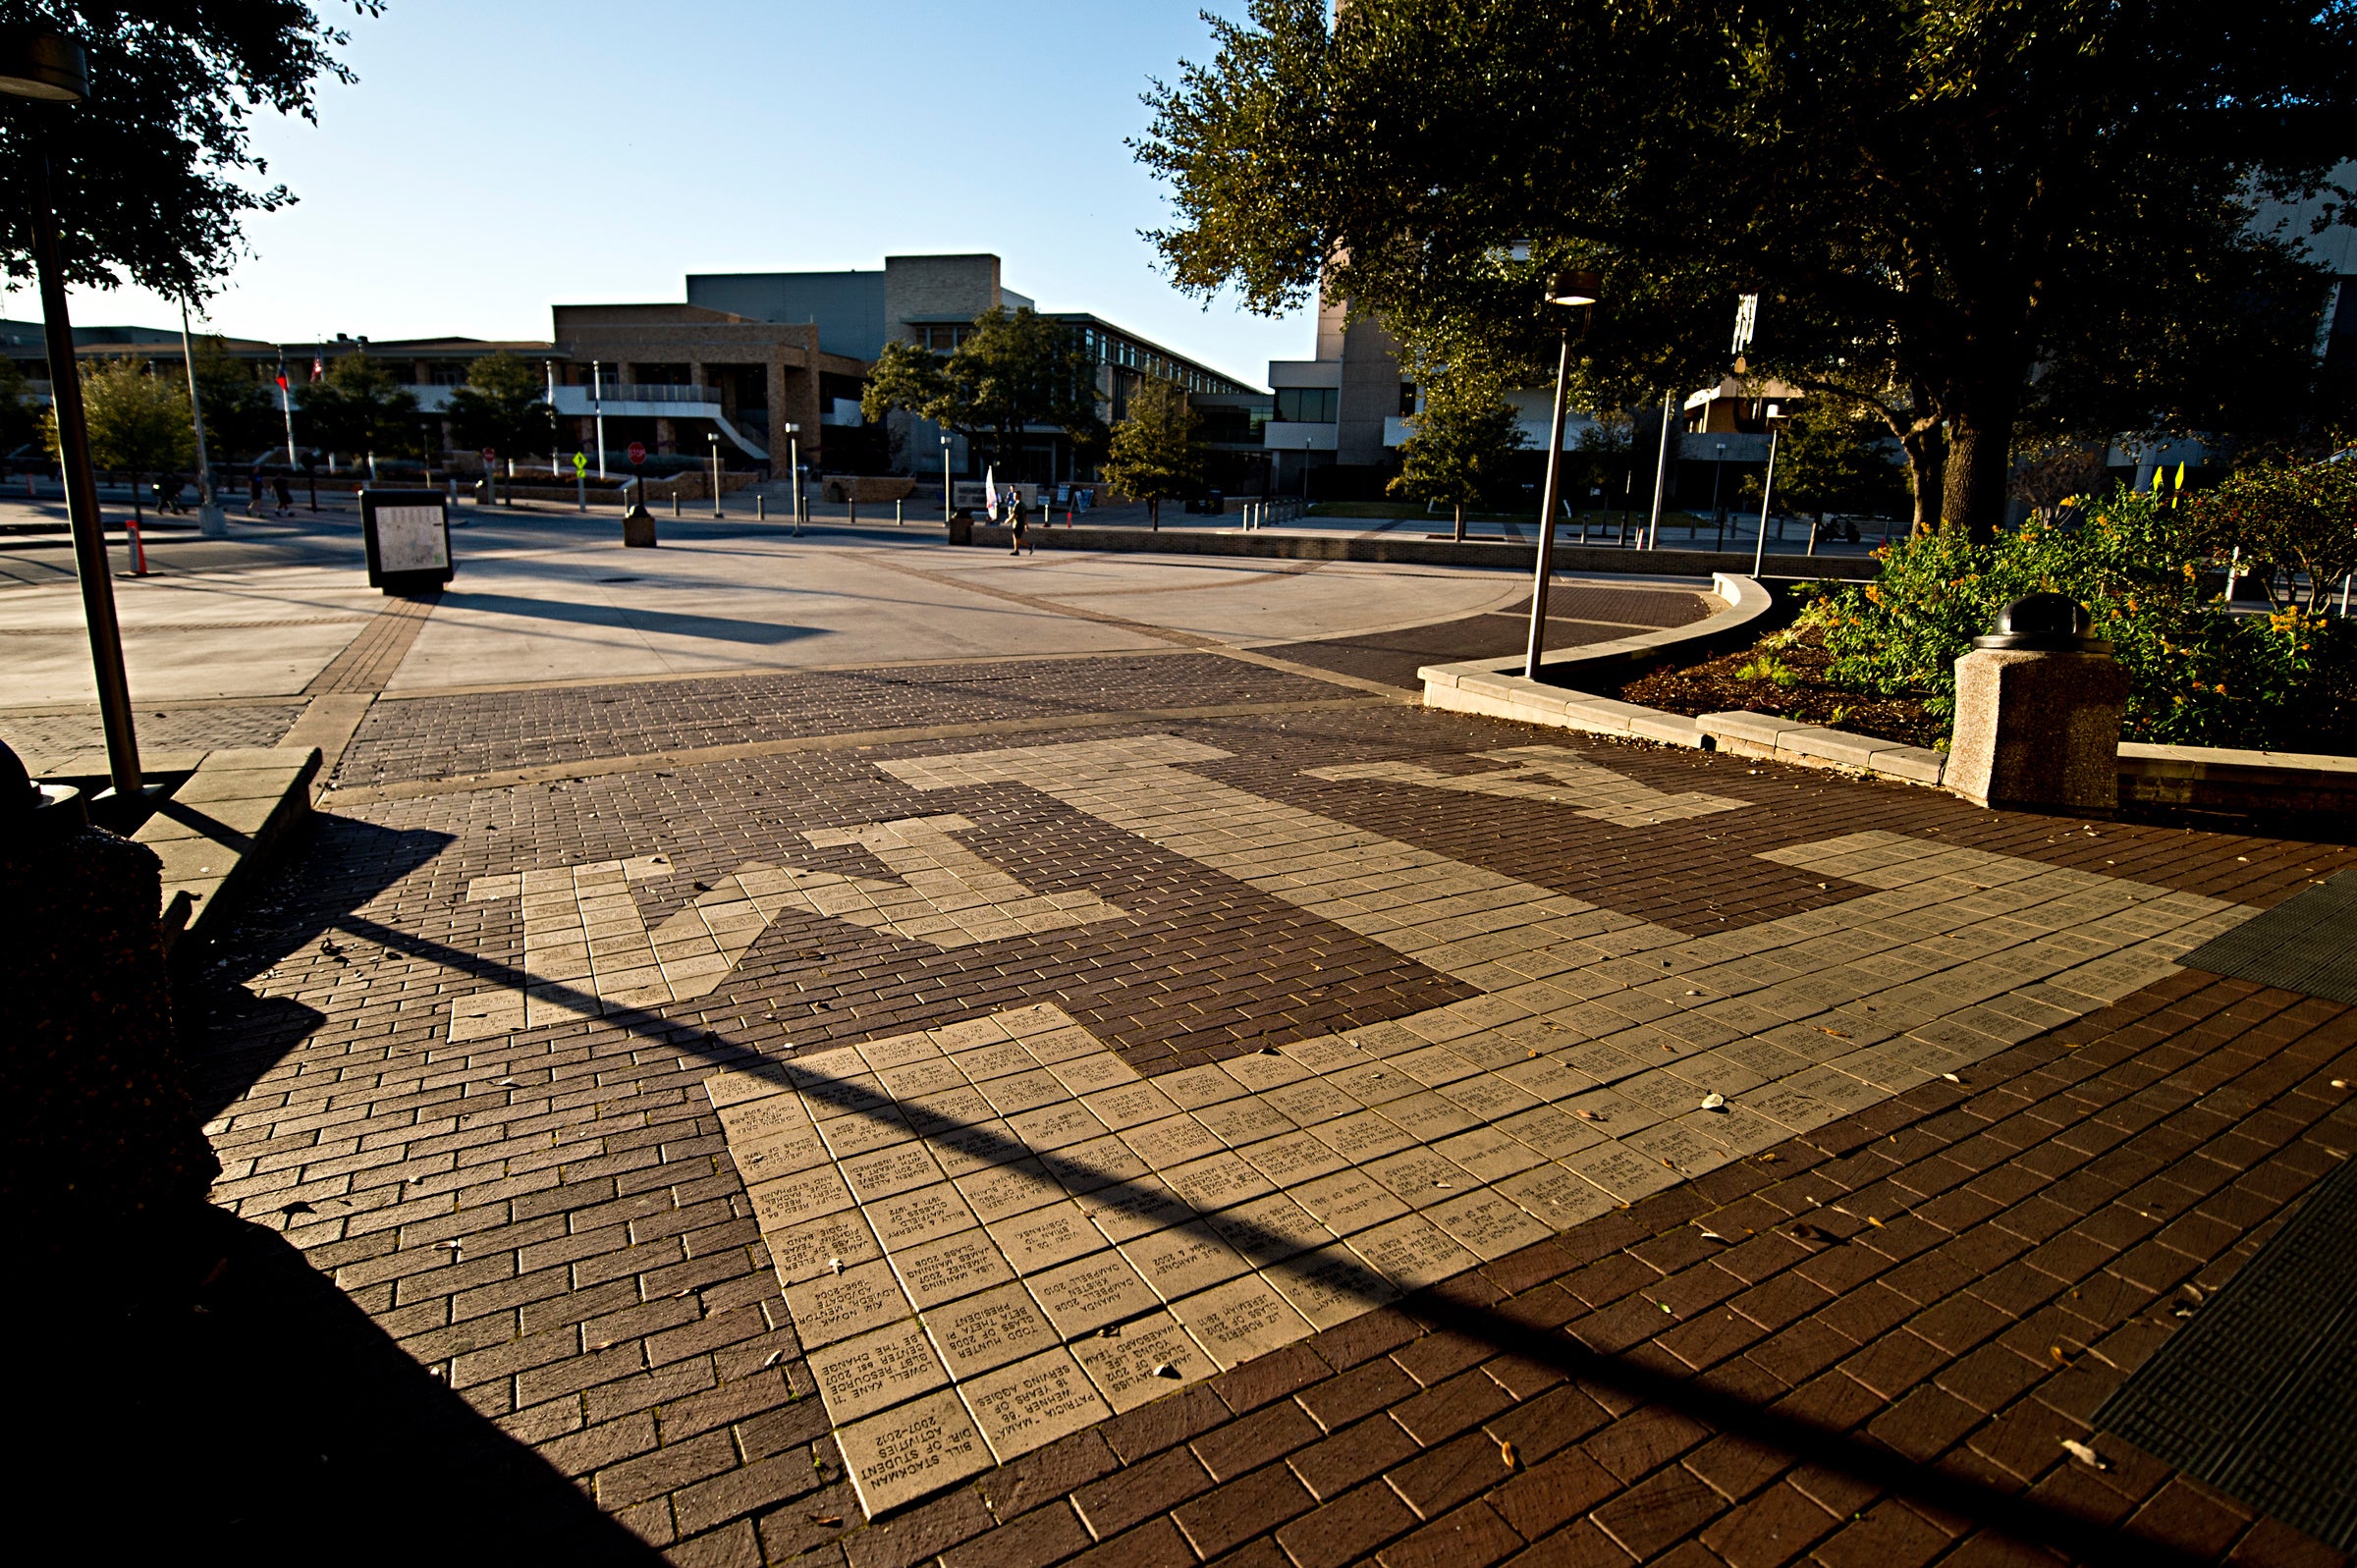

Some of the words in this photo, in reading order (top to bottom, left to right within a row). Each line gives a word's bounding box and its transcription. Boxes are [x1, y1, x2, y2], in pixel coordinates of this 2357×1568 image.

[1057, 1110, 1082, 1120] CLASS
[1066, 1120, 1089, 1129] JOHN
[783, 1137, 810, 1148] CLASS
[979, 1133, 1005, 1144] CLASS
[1288, 1138, 1316, 1149] CLASS
[896, 1150, 922, 1161] LEAVE
[900, 1157, 921, 1165] WITH
[1300, 1149, 1325, 1160] CLASS
[867, 1163, 896, 1174] HEART
[894, 1165, 911, 1174] 2011
[895, 1167, 930, 1180] LAUREN
[812, 1175, 833, 1184] AND
[861, 1178, 891, 1190] ALLEN
[1017, 1179, 1046, 1191] CLASS
[1544, 1173, 1570, 1185] CLASS
[759, 1182, 809, 1200] STEPHANIE
[806, 1186, 842, 1200] SHERYL
[967, 1186, 999, 1199] BLAINE
[1029, 1185, 1049, 1194] LISA
[1343, 1182, 1370, 1194] CLASS
[765, 1191, 801, 1205] RACHEL
[776, 1198, 801, 1209] REED
[814, 1193, 841, 1205] CLIFF
[985, 1193, 1026, 1209] PFLUGER
[784, 1203, 809, 1214] REED
[906, 1201, 948, 1217] CLASSES
[1268, 1204, 1295, 1216] CLASS
[1474, 1200, 1502, 1213] CLASS
[1546, 1208, 1562, 1217] OF
[899, 1209, 946, 1227] MAYFIELD
[939, 1211, 965, 1222] BILLY
[1276, 1210, 1303, 1222] TAMMY
[1461, 1210, 1477, 1218] OF
[1497, 1213, 1521, 1224] JOHN
[819, 1222, 849, 1236] AGGIE
[886, 1223, 924, 1238] SHERRY
[1040, 1225, 1069, 1239] BRIAN
[1271, 1218, 1305, 1233] OTHERS
[1297, 1222, 1320, 1233] DARE
[1410, 1224, 1435, 1236] PAUL
[1459, 1221, 1499, 1239] CLAYTON
[1486, 1224, 1518, 1239] HONOR
[786, 1233, 814, 1246] BAND
[831, 1234, 862, 1248] CLASS
[1377, 1237, 1402, 1250] ROSE
[1473, 1236, 1489, 1245] OF
[782, 1241, 813, 1255] TEXAS
[812, 1245, 826, 1254] OF
[835, 1240, 869, 1255] JAMES
[942, 1244, 974, 1258] CLASS
[958, 1247, 991, 1262] JAMES
[1201, 1247, 1222, 1258] SUE
[1417, 1240, 1449, 1255] FAMILY
[1432, 1245, 1464, 1261] WHERE
[784, 1257, 816, 1271] ELLER
[913, 1255, 939, 1267] 2008
[946, 1256, 989, 1273] JIMENEZ
[1151, 1253, 1176, 1266] 2002
[1152, 1255, 1199, 1275] MAHONEY
[1412, 1258, 1434, 1269] THE
[905, 1259, 954, 1278] MANNING
[972, 1263, 996, 1274] LISA
[1069, 1264, 1120, 1285] CAMPBELL
[1386, 1266, 1413, 1279] ROSE
[917, 1271, 942, 1283] 2007
[920, 1271, 968, 1291] MANNING
[1042, 1282, 1067, 1295] 2010
[1067, 1277, 1110, 1296] KRISTEN
[1082, 1277, 1134, 1301] CAMPBELL
[816, 1285, 872, 1309] ADVOCATE
[1079, 1293, 1123, 1313] AMANDA
[863, 1300, 884, 1312] KIM
[1053, 1297, 1080, 1312] 2008
[1221, 1293, 1270, 1317] JEREMIAH
[1246, 1302, 1279, 1318] CLASS
[797, 1304, 844, 1325] MENTOR
[820, 1309, 857, 1326] NOVAK
[953, 1302, 1011, 1326] PRESIDENT
[1000, 1306, 1027, 1322] BETA
[1230, 1315, 1245, 1325] OF
[1264, 1312, 1284, 1324] LIZ
[960, 1318, 997, 1334] THETA
[1000, 1315, 1034, 1331] CLASS
[1203, 1322, 1229, 1335] 2012
[945, 1331, 957, 1340] PI
[980, 1327, 996, 1338] OF
[1006, 1325, 1037, 1340] TODD
[1216, 1319, 1265, 1343] ROBERTS
[903, 1334, 918, 1345] BE
[948, 1334, 976, 1350] 2008
[1115, 1325, 1177, 1353] WAKEBOARD
[874, 1341, 898, 1355] THE
[879, 1343, 924, 1365] CENTER
[957, 1336, 1003, 1359] HUNTER
[1131, 1338, 1170, 1358] YOUNG
[1151, 1344, 1186, 1362] CLASS
[822, 1352, 870, 1375] CHANGE
[898, 1352, 928, 1369] GLBT
[1081, 1349, 1113, 1366] TEAM
[1104, 1354, 1130, 1370] LIFE
[1132, 1359, 1149, 1370] OF
[824, 1369, 851, 1385] 2007
[889, 1361, 934, 1383] LOWELL
[1021, 1364, 1070, 1388] SERVING
[1104, 1367, 1129, 1381] 2012
[830, 1366, 893, 1394] RESOURCE
[1110, 1369, 1157, 1392] BAYLISS
[851, 1379, 884, 1398] KANE
[975, 1384, 1019, 1407] AGGIES
[1014, 1384, 1050, 1404] YEARS
[992, 1400, 1011, 1414] OF
[1023, 1388, 1072, 1413] WEHNER
[1043, 1392, 1095, 1419] PATRICIA
[874, 1415, 937, 1446] 2007-2012
[947, 1427, 972, 1443] DIR.
[877, 1426, 944, 1459] ACTIVITIES
[924, 1439, 942, 1453] OF
[944, 1440, 972, 1459] BILL
[859, 1448, 919, 1480] STUDENT
[869, 1454, 940, 1489] STACKMAN
